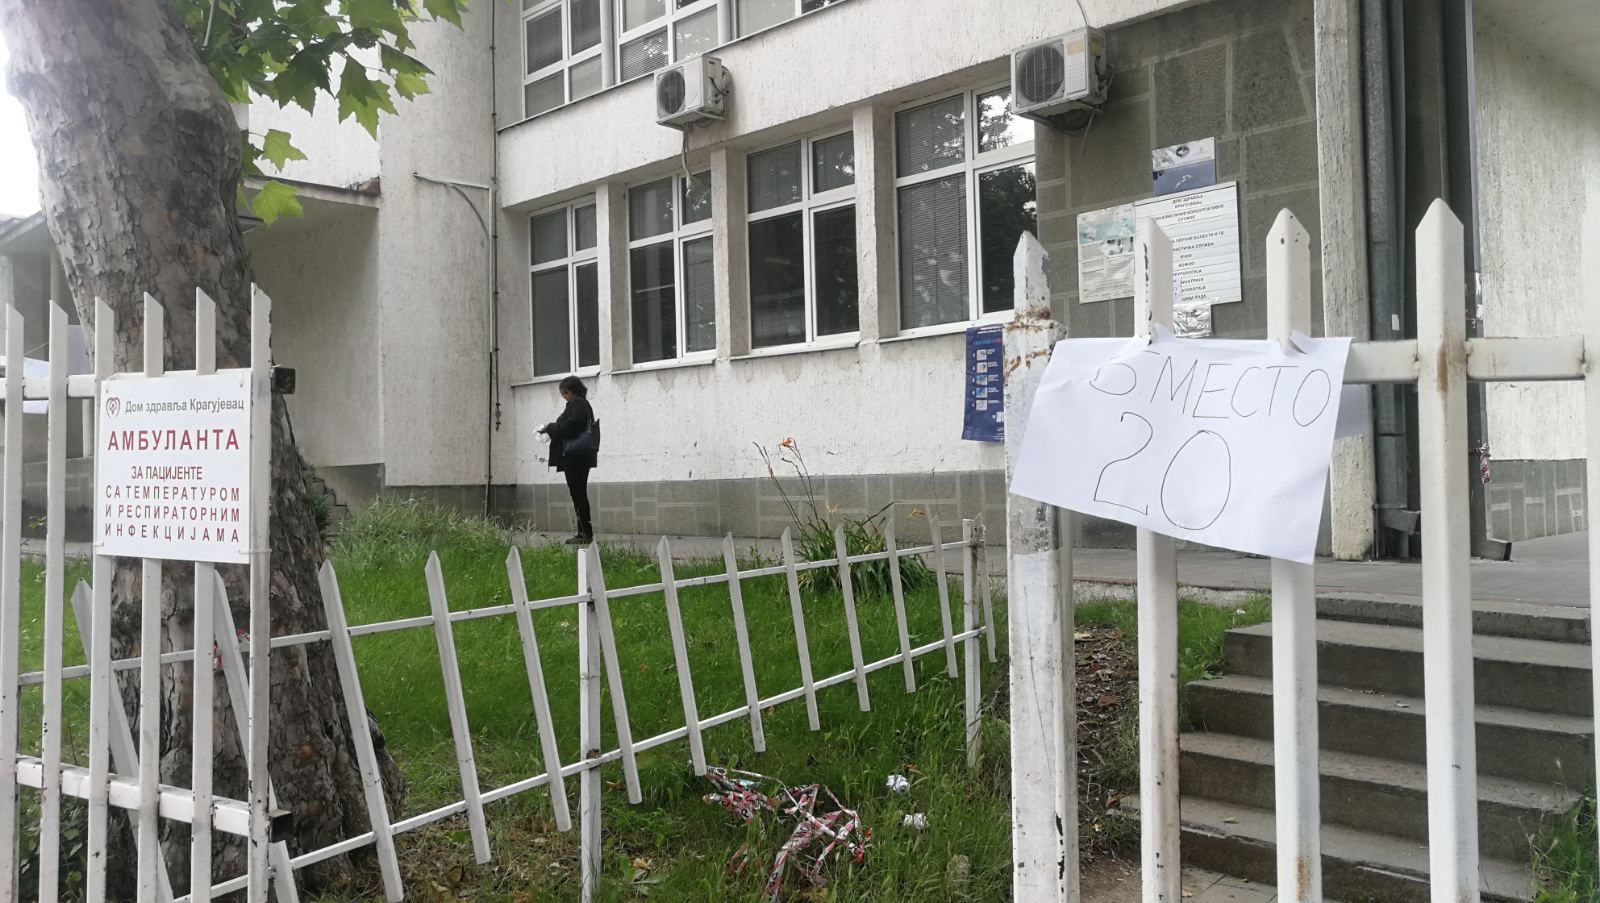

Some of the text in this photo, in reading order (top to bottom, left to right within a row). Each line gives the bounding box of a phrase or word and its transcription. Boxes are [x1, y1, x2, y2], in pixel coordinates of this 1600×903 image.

[1150, 356, 1331, 427] МЕСТО
[126, 398, 244, 414] Дом здравља Крагујевац
[108, 429, 239, 450] АМБУЛАНТА
[131, 466, 203, 482] ЗА ПАЦИЈЕНТЕ
[1093, 411, 1232, 531] 20
[106, 485, 240, 502] СА ТЕМПЕРАТУРОМ
[105, 504, 240, 522] И РЕСПИРАТОРНИМ
[105, 524, 239, 542] ИНФЕКЦИЈАМА
